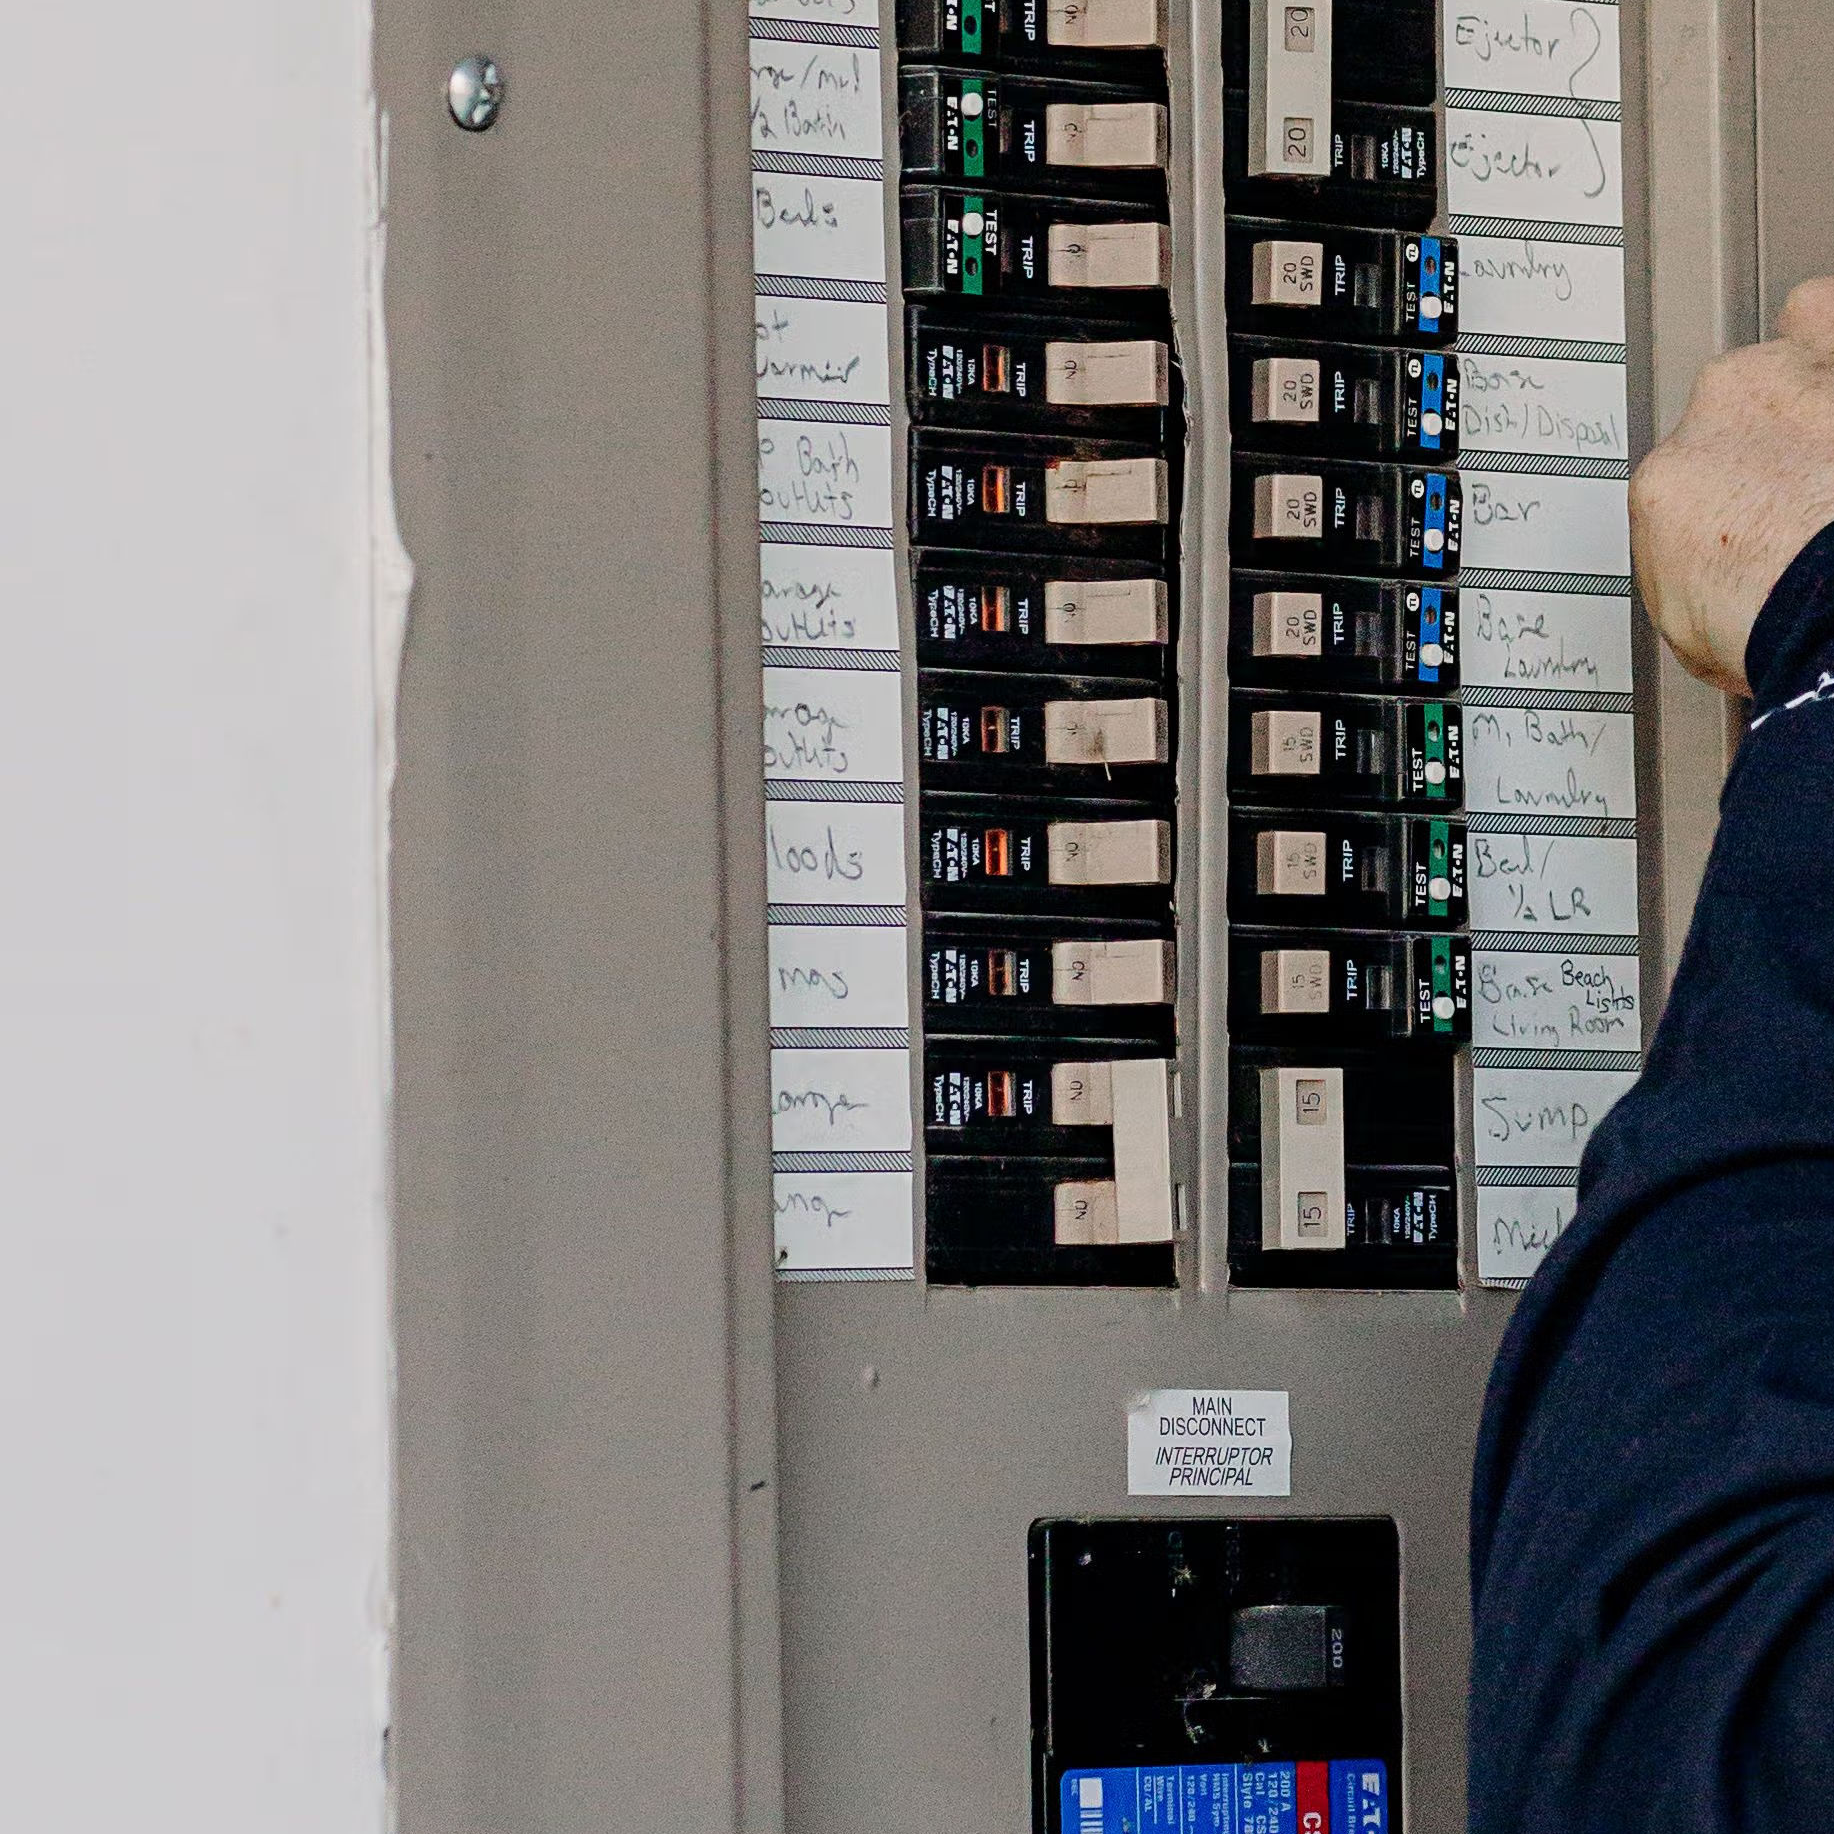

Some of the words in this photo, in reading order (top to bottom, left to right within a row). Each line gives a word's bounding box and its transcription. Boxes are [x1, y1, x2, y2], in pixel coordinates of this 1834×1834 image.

[1023, 0, 1036, 42] TRIP
[1290, 8, 1309, 38] 20
[1288, 127, 1306, 158] 20
[983, 209, 997, 257] TEST
[1021, 236, 1034, 279] TRIP
[1300, 254, 1314, 291] SWD
[1335, 254, 1346, 295] TRIP
[1015, 481, 1027, 517] TRIP
[1304, 491, 1318, 528] SWD
[1335, 487, 1346, 528] TRIP
[1409, 517, 1420, 558] TEST
[1010, 716, 1021, 751] TRIP
[1412, 748, 1424, 792] TEST
[1342, 839, 1353, 882] TRIP
[1415, 862, 1427, 907] TEST
[1549, 888, 1592, 922] LR
[1019, 958, 1030, 994] TRIP
[1560, 959, 1614, 993] Beach
[1302, 1091, 1322, 1115] 15
[1303, 1204, 1322, 1229] 15
[1192, 1396, 1232, 1416] MAIN
[1159, 1417, 1267, 1437] DISCONNECT
[1155, 1446, 1274, 1466] INTERRUPTOR
[1168, 1466, 1254, 1487] PRINCIPAL
[1330, 1628, 1344, 1668] 200
[1281, 1771, 1291, 1798] 200
